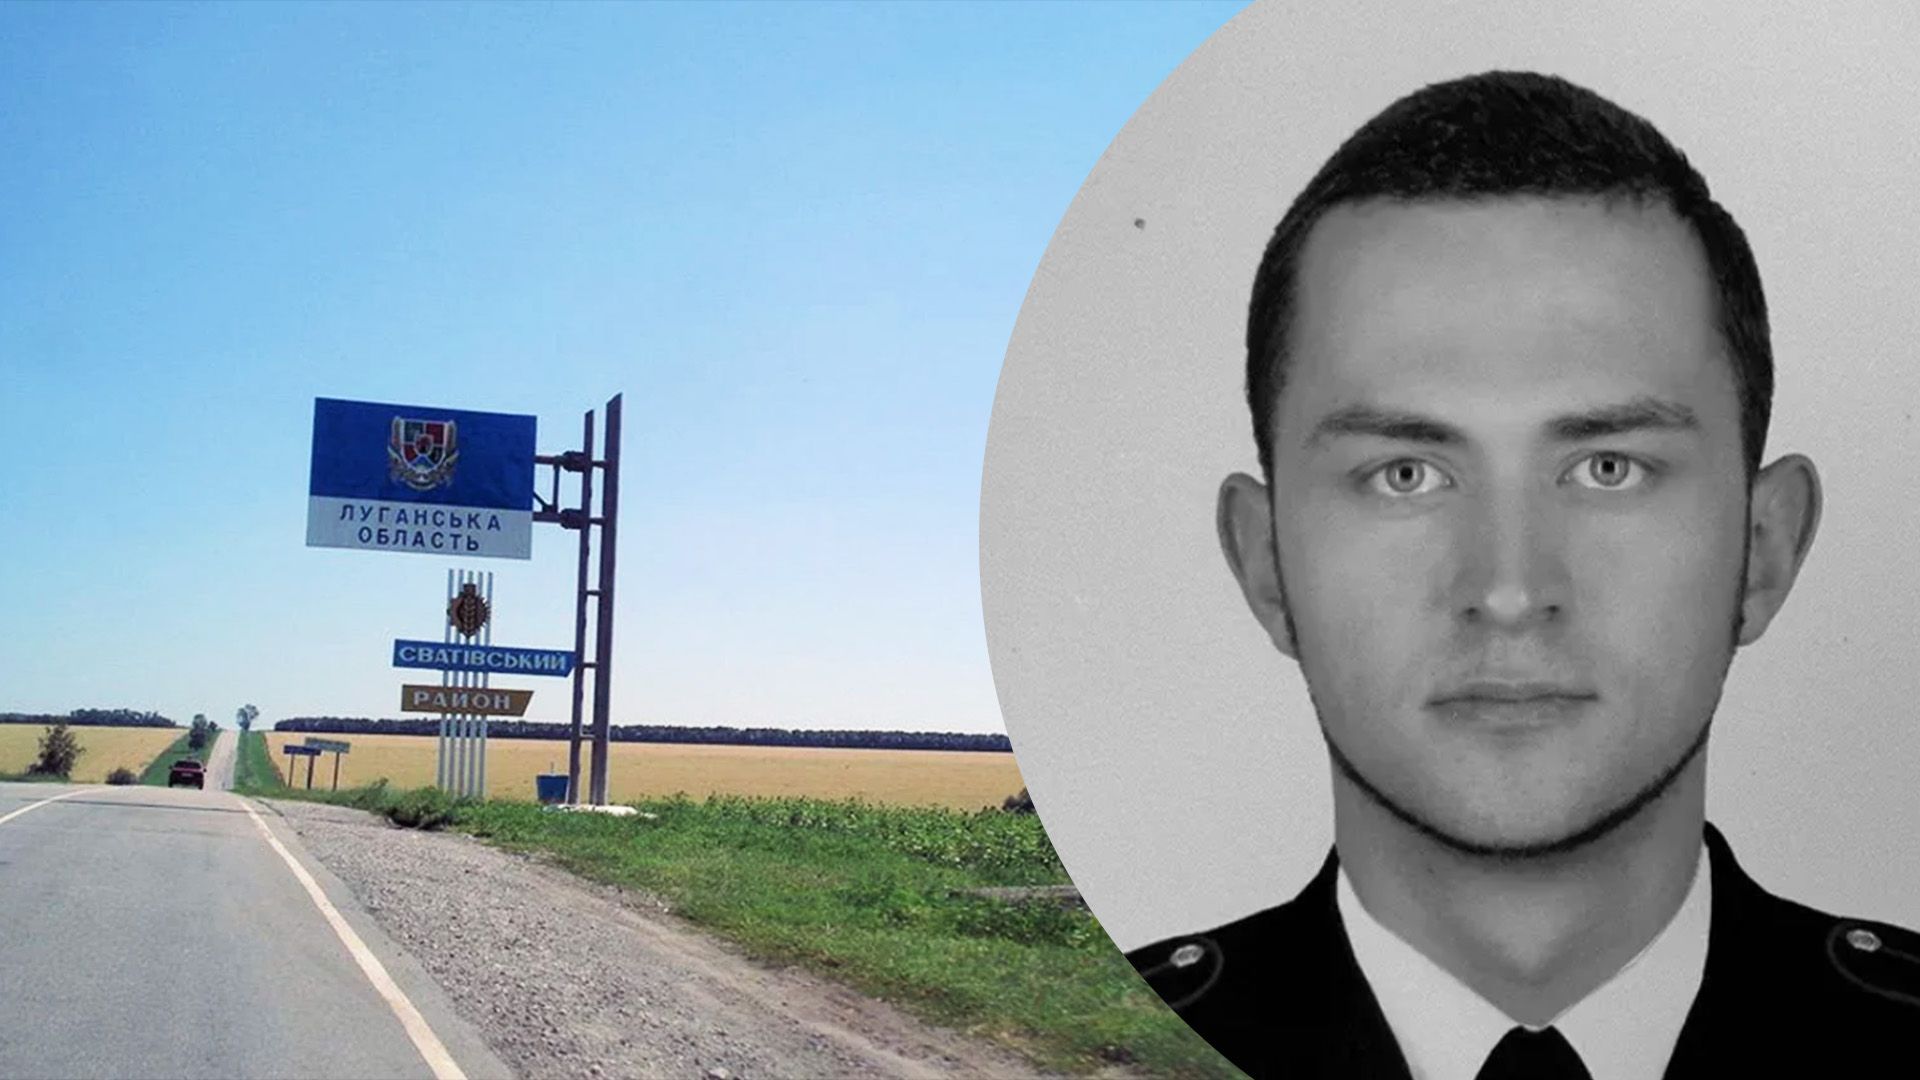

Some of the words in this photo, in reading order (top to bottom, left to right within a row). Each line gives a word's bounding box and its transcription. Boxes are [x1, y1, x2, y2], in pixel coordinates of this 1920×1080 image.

[340, 504, 501, 531] ЛУГАНСЬКА
[358, 526, 479, 551] ОБЛАСТЬ
[399, 647, 567, 670] СВАТІВСЬКИЙ
[413, 690, 510, 709] РАЙОН
